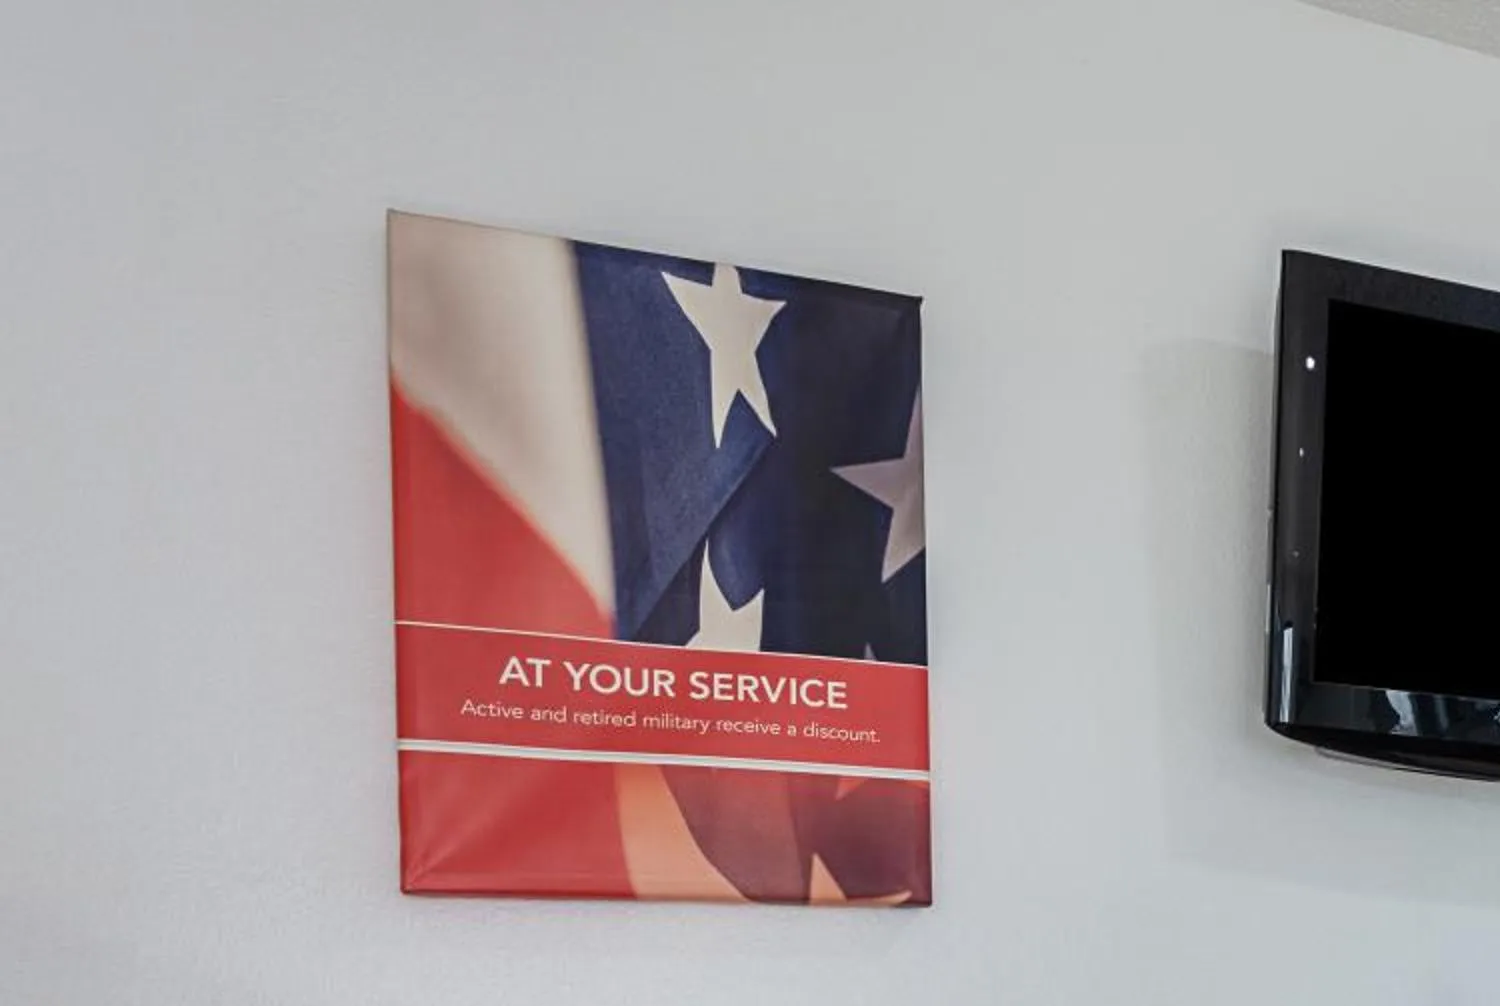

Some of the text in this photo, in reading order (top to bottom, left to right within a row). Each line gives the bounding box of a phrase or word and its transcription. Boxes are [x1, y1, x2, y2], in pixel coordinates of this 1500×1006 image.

[499, 656, 848, 710] AT YOUR SERVICE
[461, 699, 880, 744] Active and retired military receive a discount.
